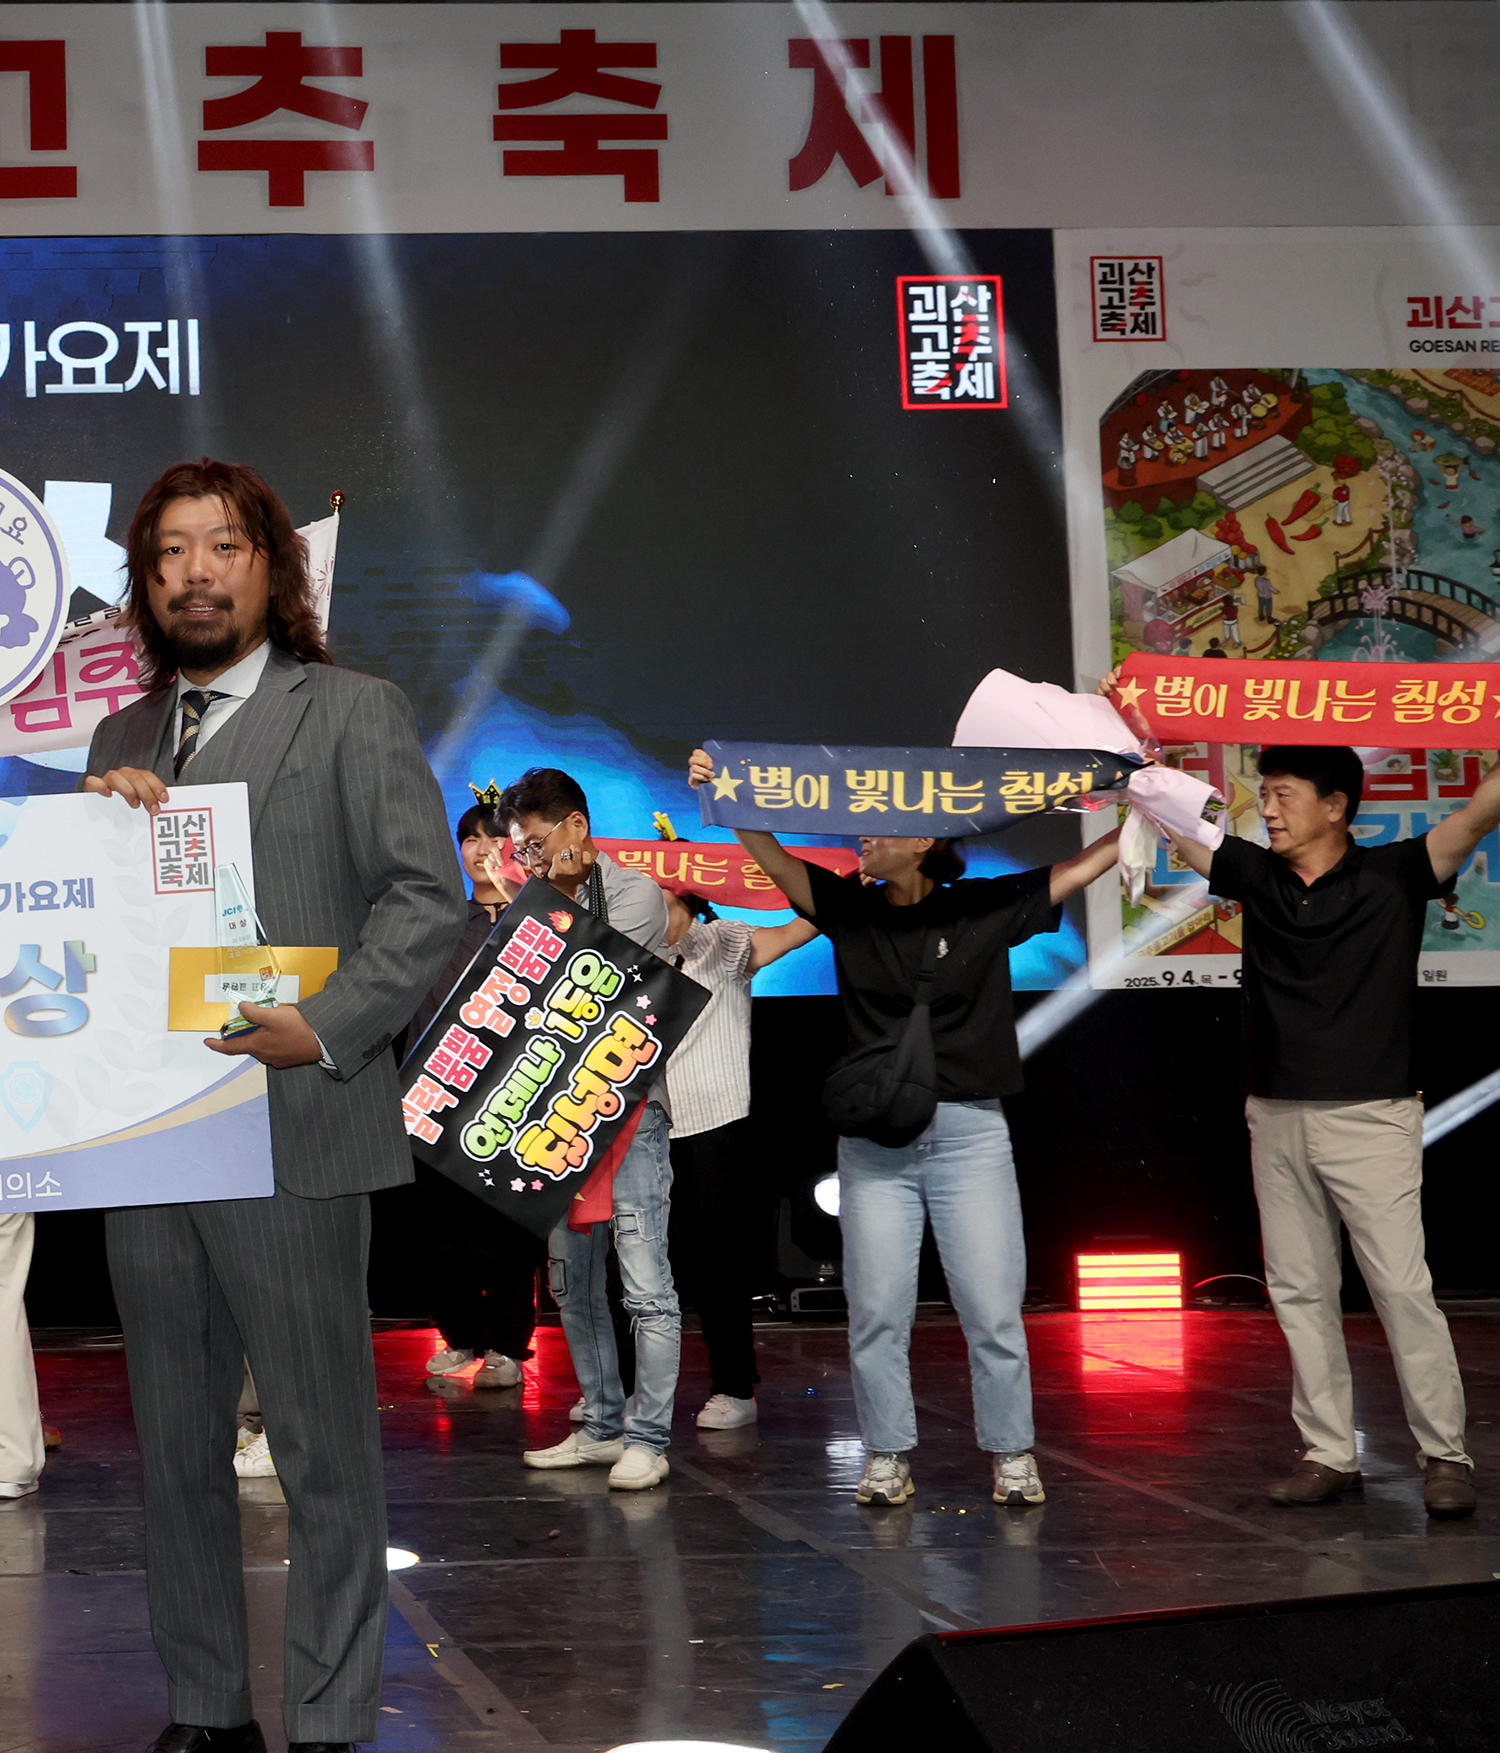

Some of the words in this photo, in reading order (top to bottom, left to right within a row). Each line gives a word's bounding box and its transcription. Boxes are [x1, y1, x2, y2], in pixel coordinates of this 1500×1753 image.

[1098, 261, 1155, 285] 괴산
[908, 284, 992, 323] 괴산
[1099, 286, 1155, 311] 고추
[1100, 310, 1157, 335] 축제
[910, 321, 993, 363] 고추
[1409, 340, 1477, 353] GOESAN
[911, 361, 996, 401] 축제
[1154, 676, 1228, 718] 별이
[1243, 679, 1377, 722] 빛나는
[1391, 680, 1487, 724] 칠성
[749, 766, 829, 810] 별이
[845, 769, 985, 814] 빛나는
[157, 814, 206, 838] 괴산
[159, 838, 208, 863] 고추
[160, 862, 209, 887] 축제
[222, 907, 236, 917] JCI
[1422, 969, 1448, 982] 일원
[424, 1023, 493, 1092] 뿜뿜
[459, 968, 531, 1038] 열정
[496, 914, 567, 985] 뿜뿜
[460, 1035, 566, 1162] 언제나
[543, 948, 626, 1043] 1등은
[510, 1010, 663, 1181] 칠성면
[1300, 1697, 1391, 1724] Meyer
